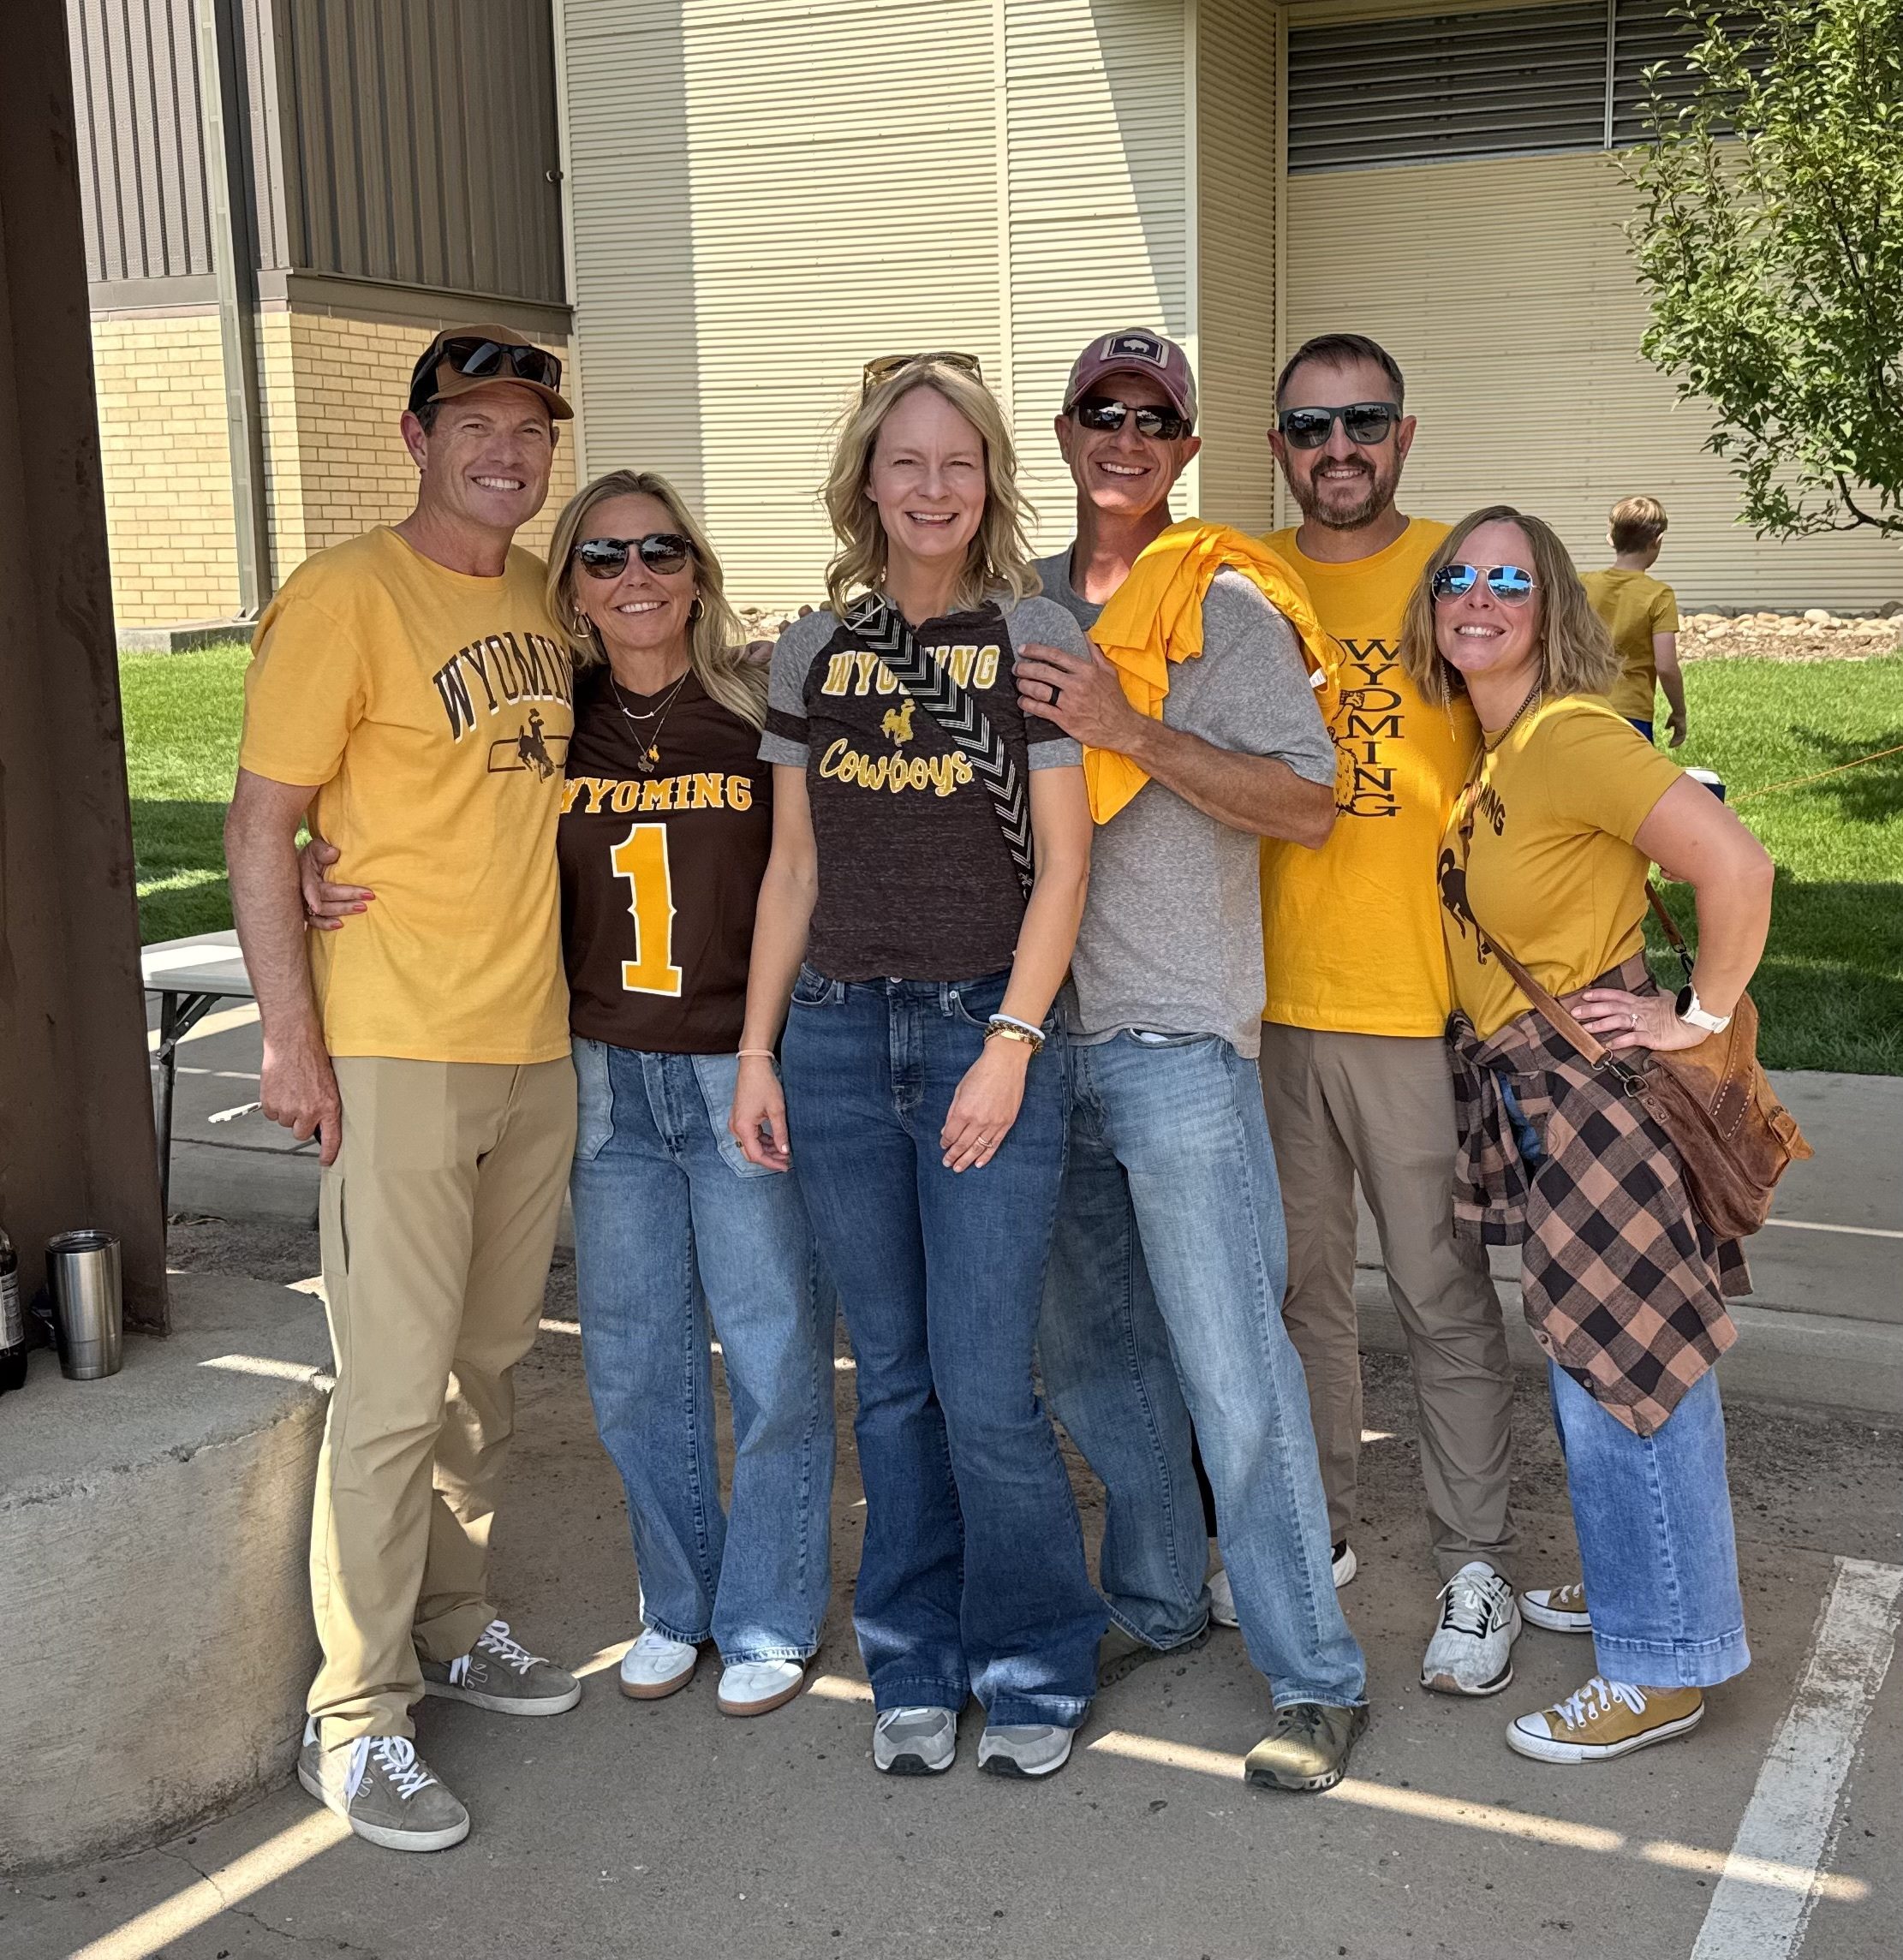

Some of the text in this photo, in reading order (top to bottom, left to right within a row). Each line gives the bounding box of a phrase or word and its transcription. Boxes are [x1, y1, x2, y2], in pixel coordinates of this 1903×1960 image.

[432, 632, 572, 744] WYOMIN
[821, 645, 1000, 696] WYONG
[820, 738, 973, 797] Cowboys
[1339, 639, 1405, 817] WYOMING
[559, 773, 752, 813] WYOMING
[610, 823, 683, 998] 1
